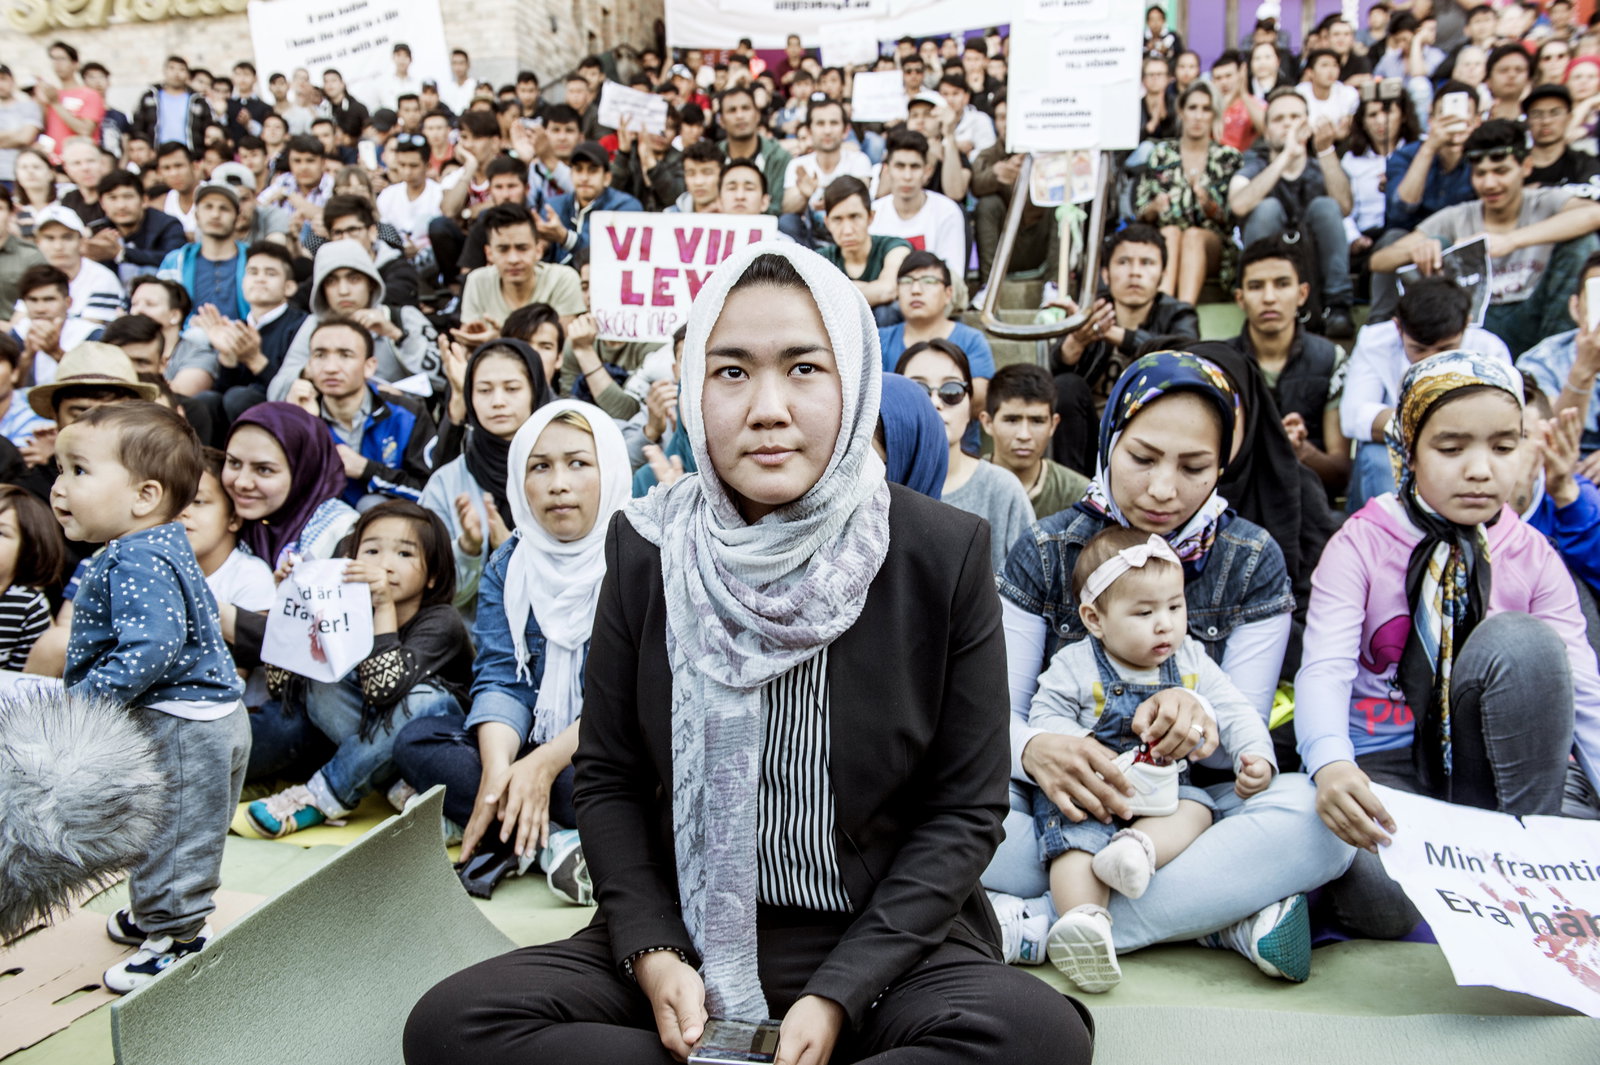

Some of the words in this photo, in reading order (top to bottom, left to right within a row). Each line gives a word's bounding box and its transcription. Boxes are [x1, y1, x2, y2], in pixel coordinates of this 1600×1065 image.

[606, 226, 653, 262] VI
[1424, 841, 1486, 874] Min
[1492, 852, 1600, 882] framti
[1435, 888, 1516, 929] Era
